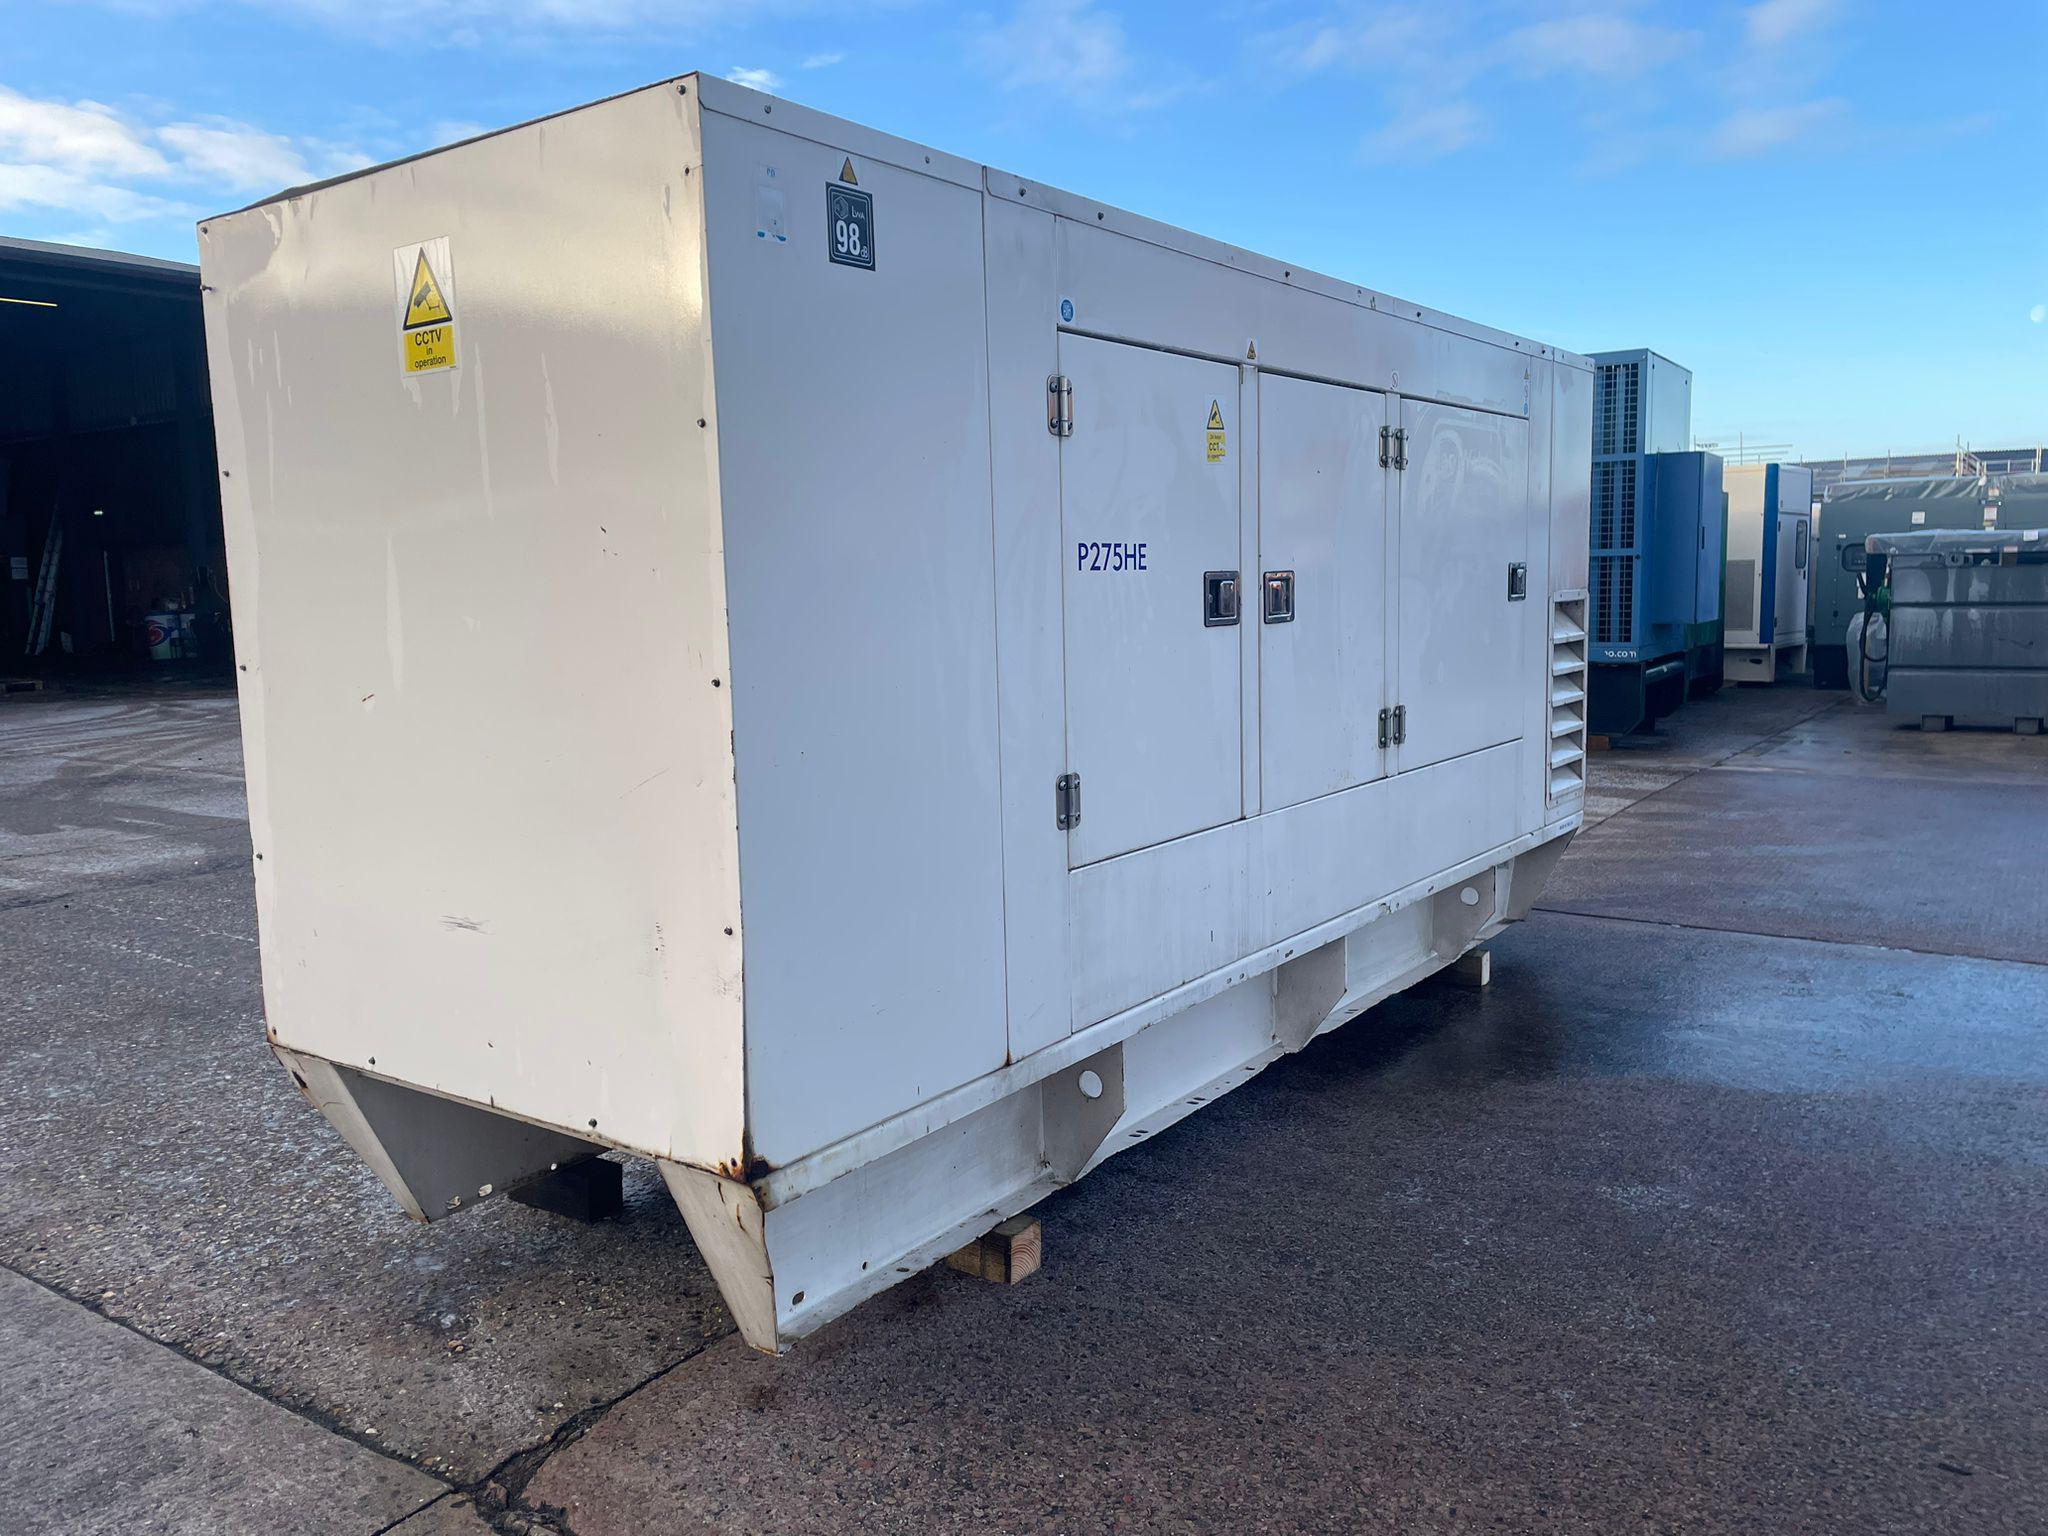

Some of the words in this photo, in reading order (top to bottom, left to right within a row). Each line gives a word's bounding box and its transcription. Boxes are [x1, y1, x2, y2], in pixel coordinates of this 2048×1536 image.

[836, 220, 860, 255] 98
[415, 328, 442, 346] CCTV
[426, 346, 433, 355] in
[415, 355, 447, 370] operation
[1078, 542, 1147, 571] P275HE
